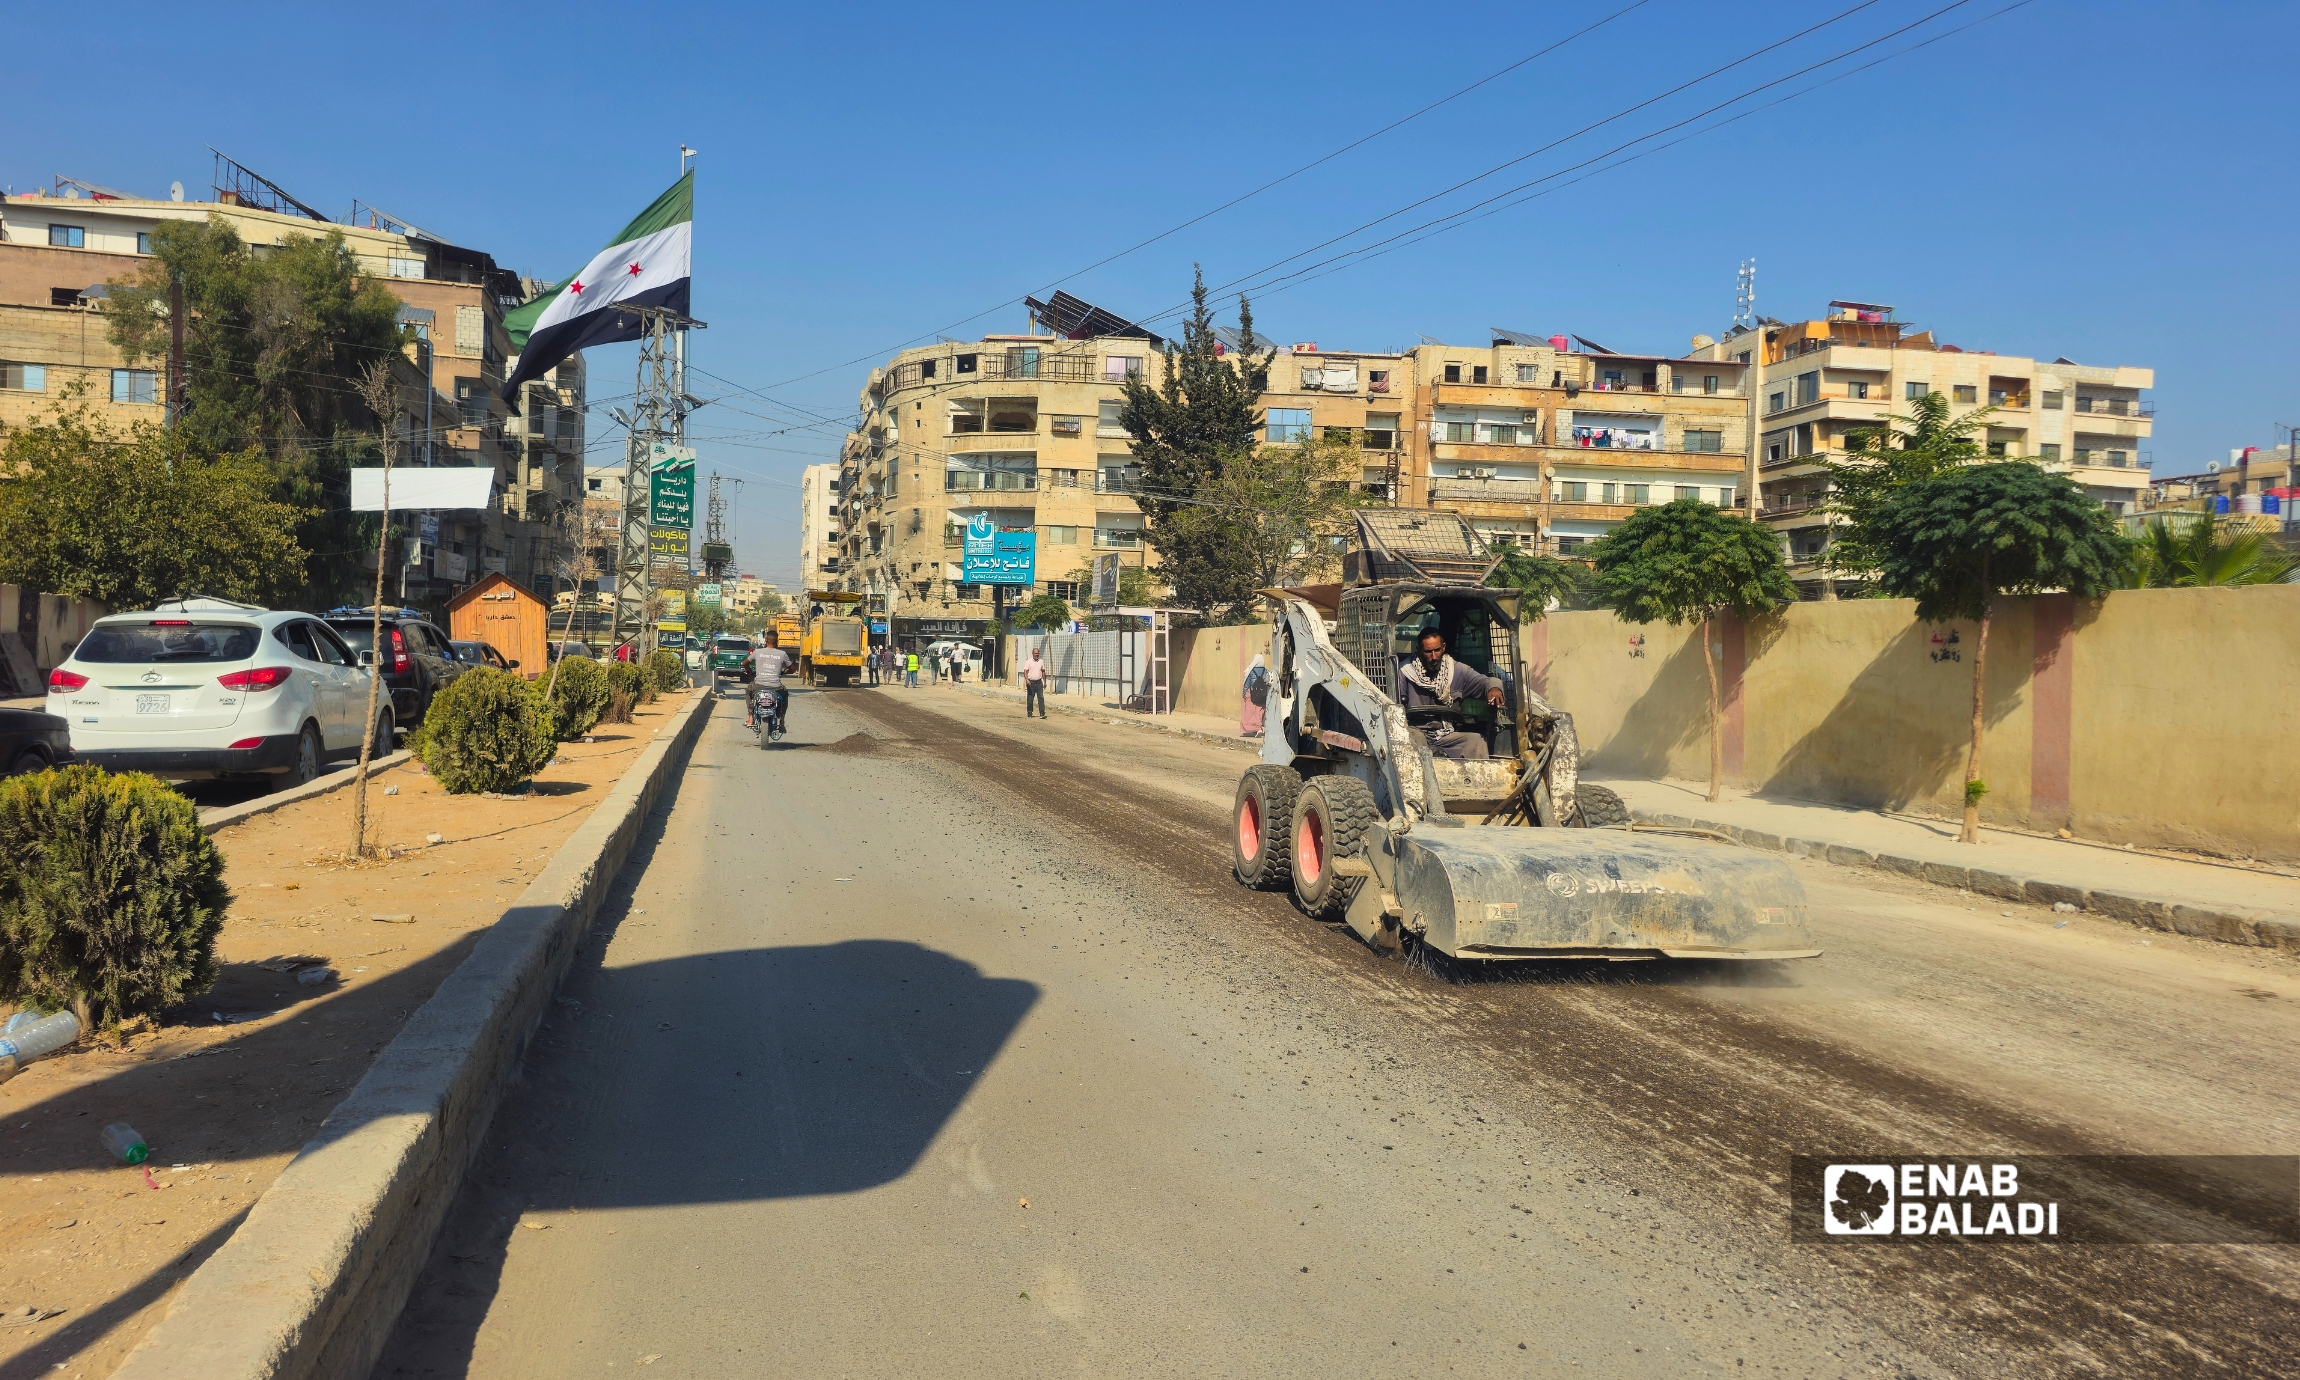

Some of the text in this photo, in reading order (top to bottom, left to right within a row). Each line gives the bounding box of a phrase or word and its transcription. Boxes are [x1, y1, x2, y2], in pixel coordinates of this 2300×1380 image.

[660, 473, 687, 485] داريا
[681, 516, 689, 526] يا
[650, 530, 687, 541] مأكولات
[650, 542, 687, 554] أبو زيد
[998, 540, 1030, 554] مؤسسة
[966, 556, 1030, 572] فاتح للإعلان
[139, 703, 168, 713] 9726
[1586, 879, 1704, 894] SWEEPS
